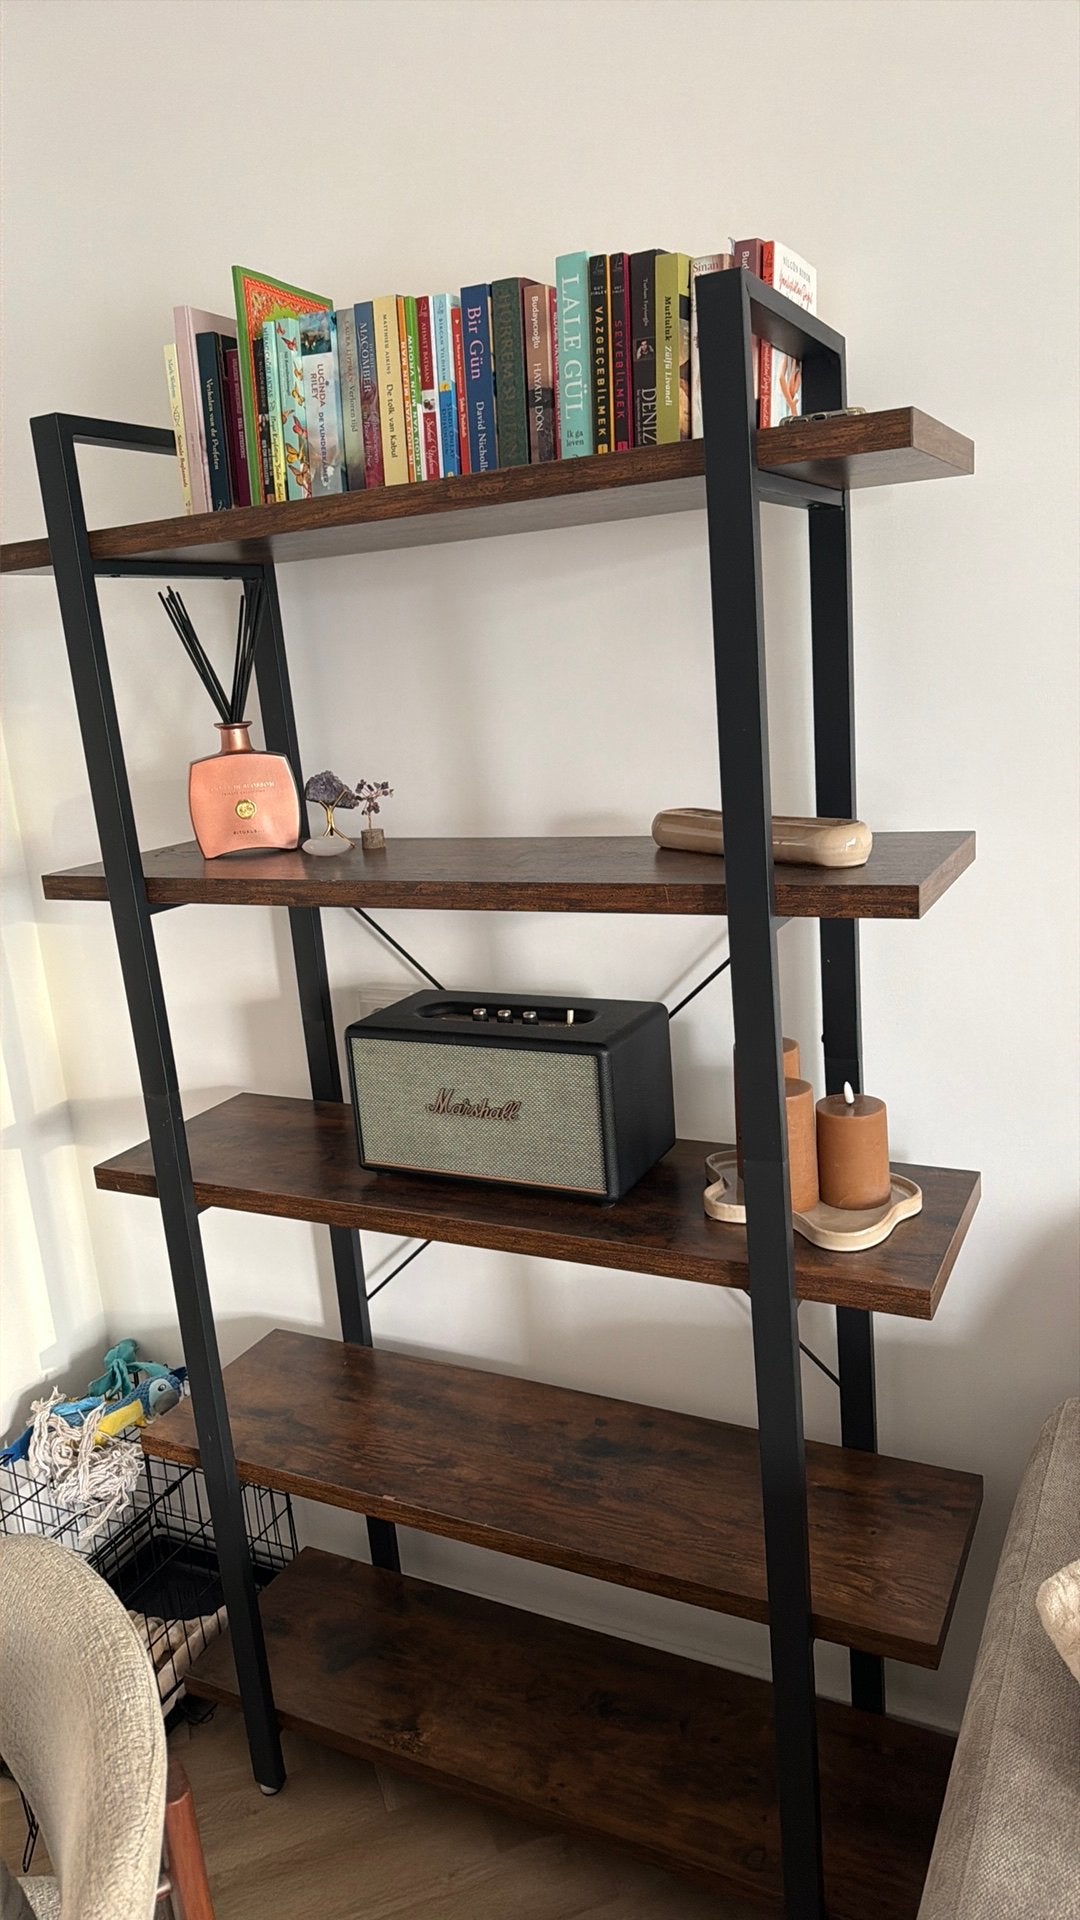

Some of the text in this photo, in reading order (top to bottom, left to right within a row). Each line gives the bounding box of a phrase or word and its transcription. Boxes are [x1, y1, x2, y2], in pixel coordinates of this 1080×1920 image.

[693, 261, 719, 273] Sinan
[531, 296, 540, 349] Budayıcıoğlu
[360, 322, 372, 393] MACOMBER
[420, 322, 431, 383] AHMET BATMAN
[467, 306, 484, 379] Bir Gün
[562, 273, 587, 419] LALE GÜL
[664, 346, 672, 369] Zülfü
[317, 363, 326, 407] LUCINDA
[533, 363, 543, 402] HAYATA
[594, 306, 607, 436] VAZGEÇEBİLMEK
[614, 320, 626, 418] SEVEBİLMEK
[310, 373, 319, 400] RILEY
[387, 384, 393, 396] De
[665, 372, 673, 406] Livaneli
[387, 399, 395, 415] tolk
[476, 401, 486, 430] David
[210, 428, 217, 437] de
[318, 412, 328, 482] DE VLINDERKAMER
[390, 434, 398, 458] Kabul
[417, 465, 421, 475] IK
[425, 1087, 523, 1121] Marshall
